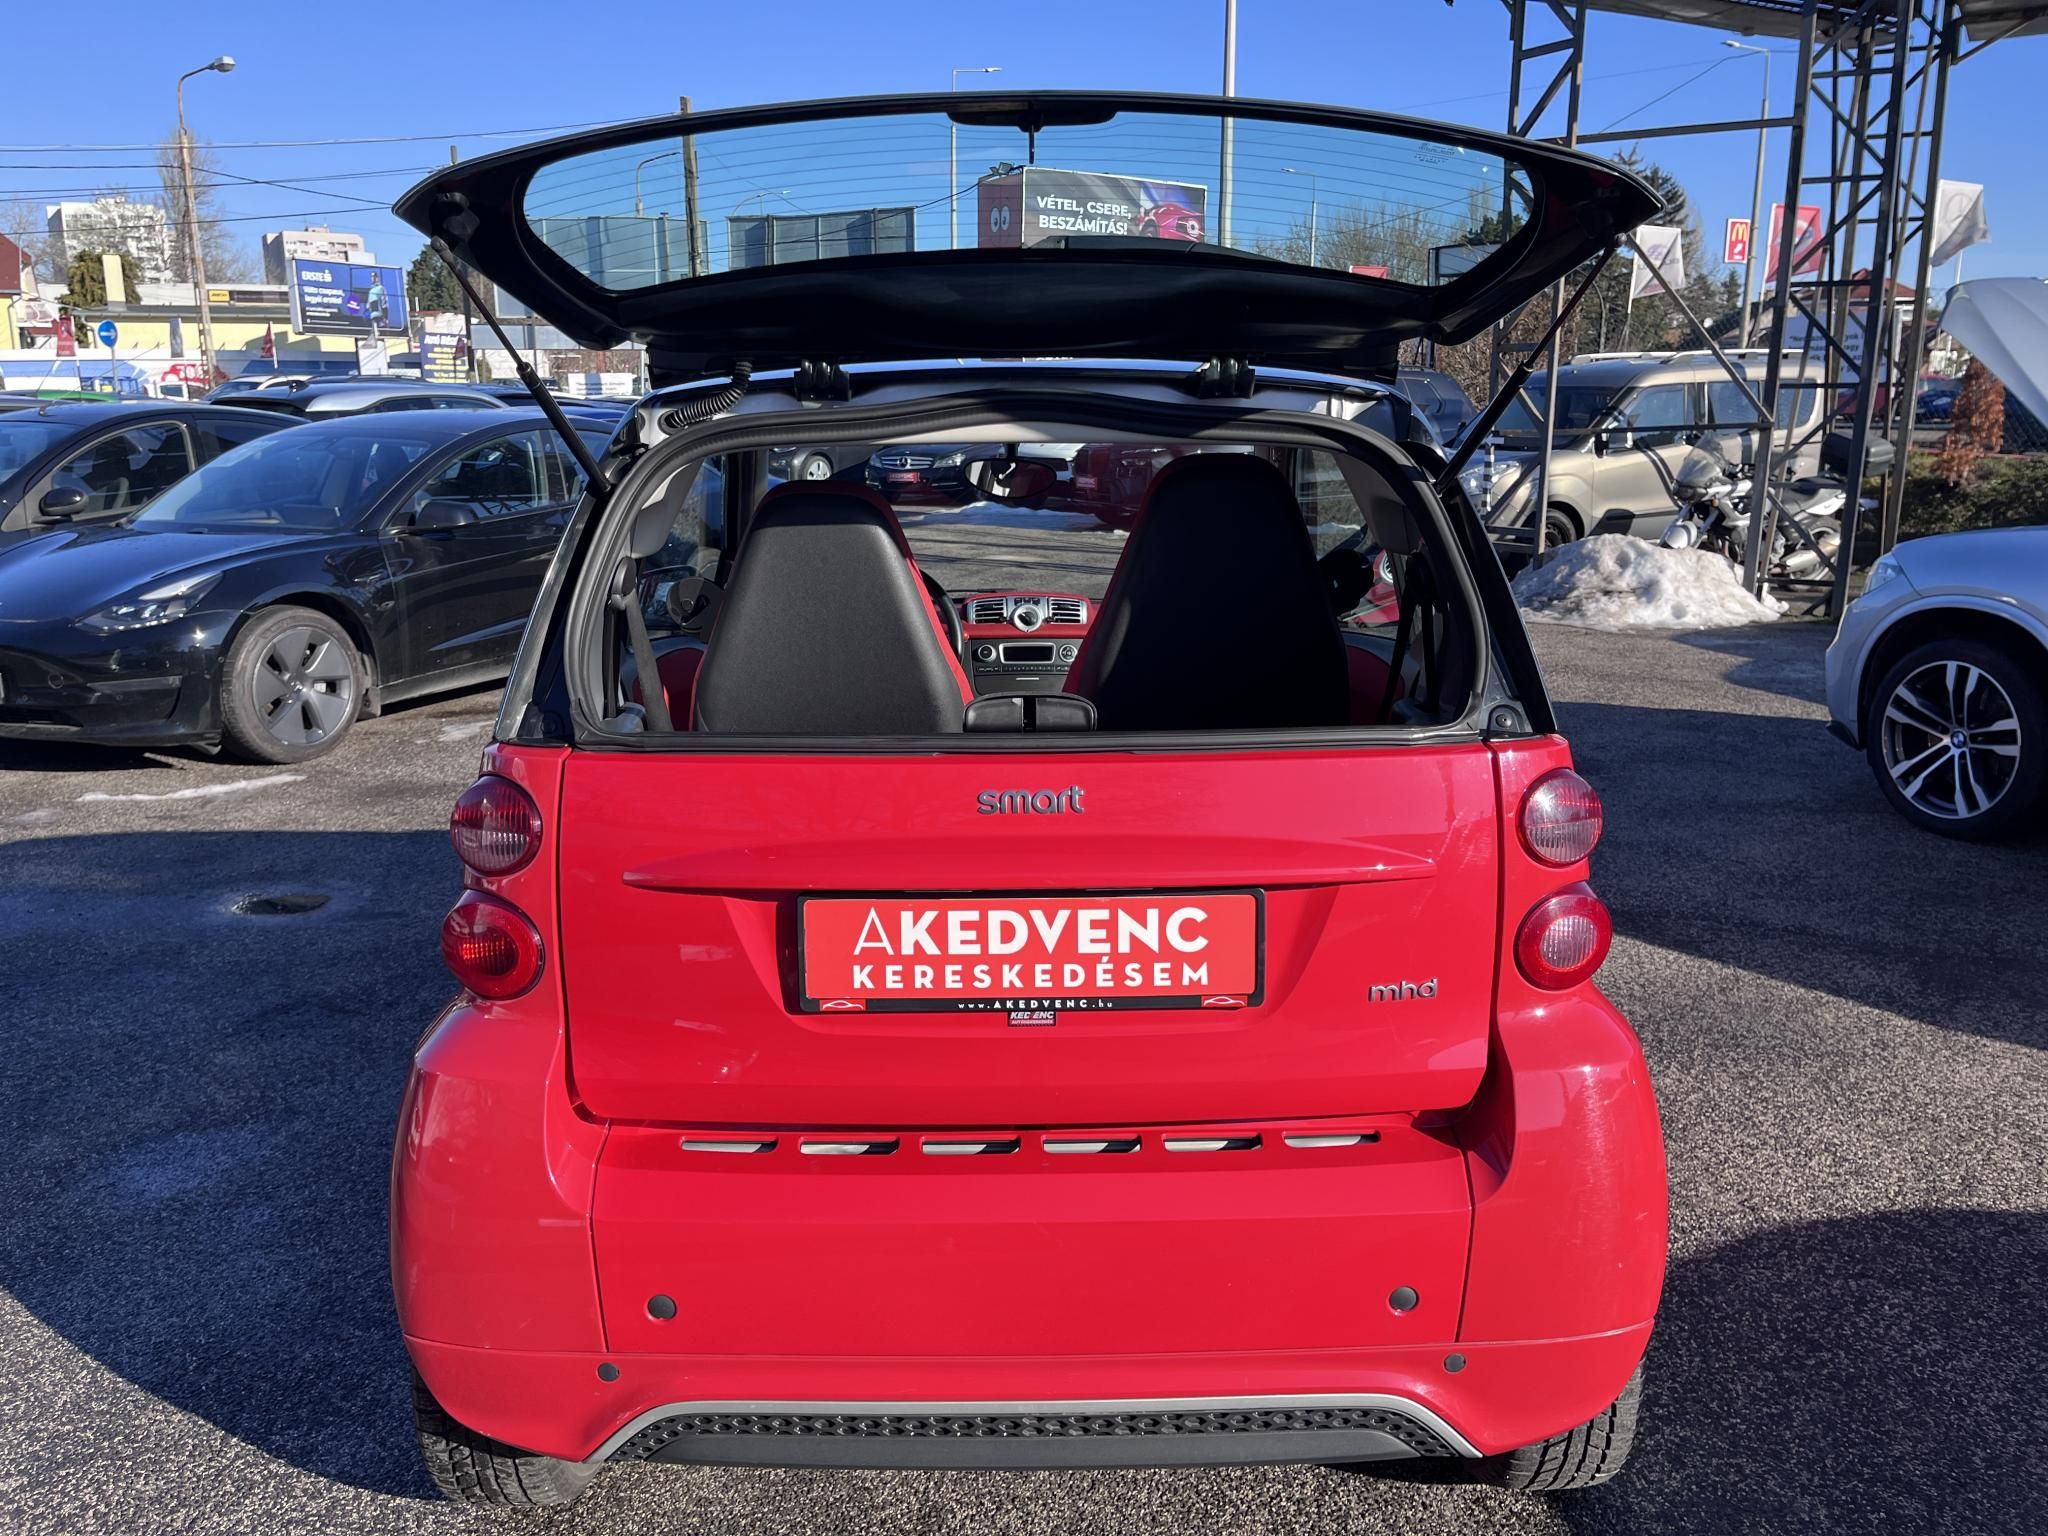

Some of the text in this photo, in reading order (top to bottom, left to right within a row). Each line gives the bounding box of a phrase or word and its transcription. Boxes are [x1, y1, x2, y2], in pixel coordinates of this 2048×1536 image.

[1037, 195, 1132, 219] VÉTEL, CSERE,
[1039, 215, 1128, 235] BESZÁMÍTÁS!
[976, 785, 1084, 815] smart
[853, 906, 1209, 955] AKEDVENC
[853, 955, 1209, 989] KERESKEDÉSEM
[1368, 978, 1438, 1002] mhd
[958, 999, 1113, 1009] www.AKEDVENC.hu
[1010, 1011, 1055, 1019] KEDENC
